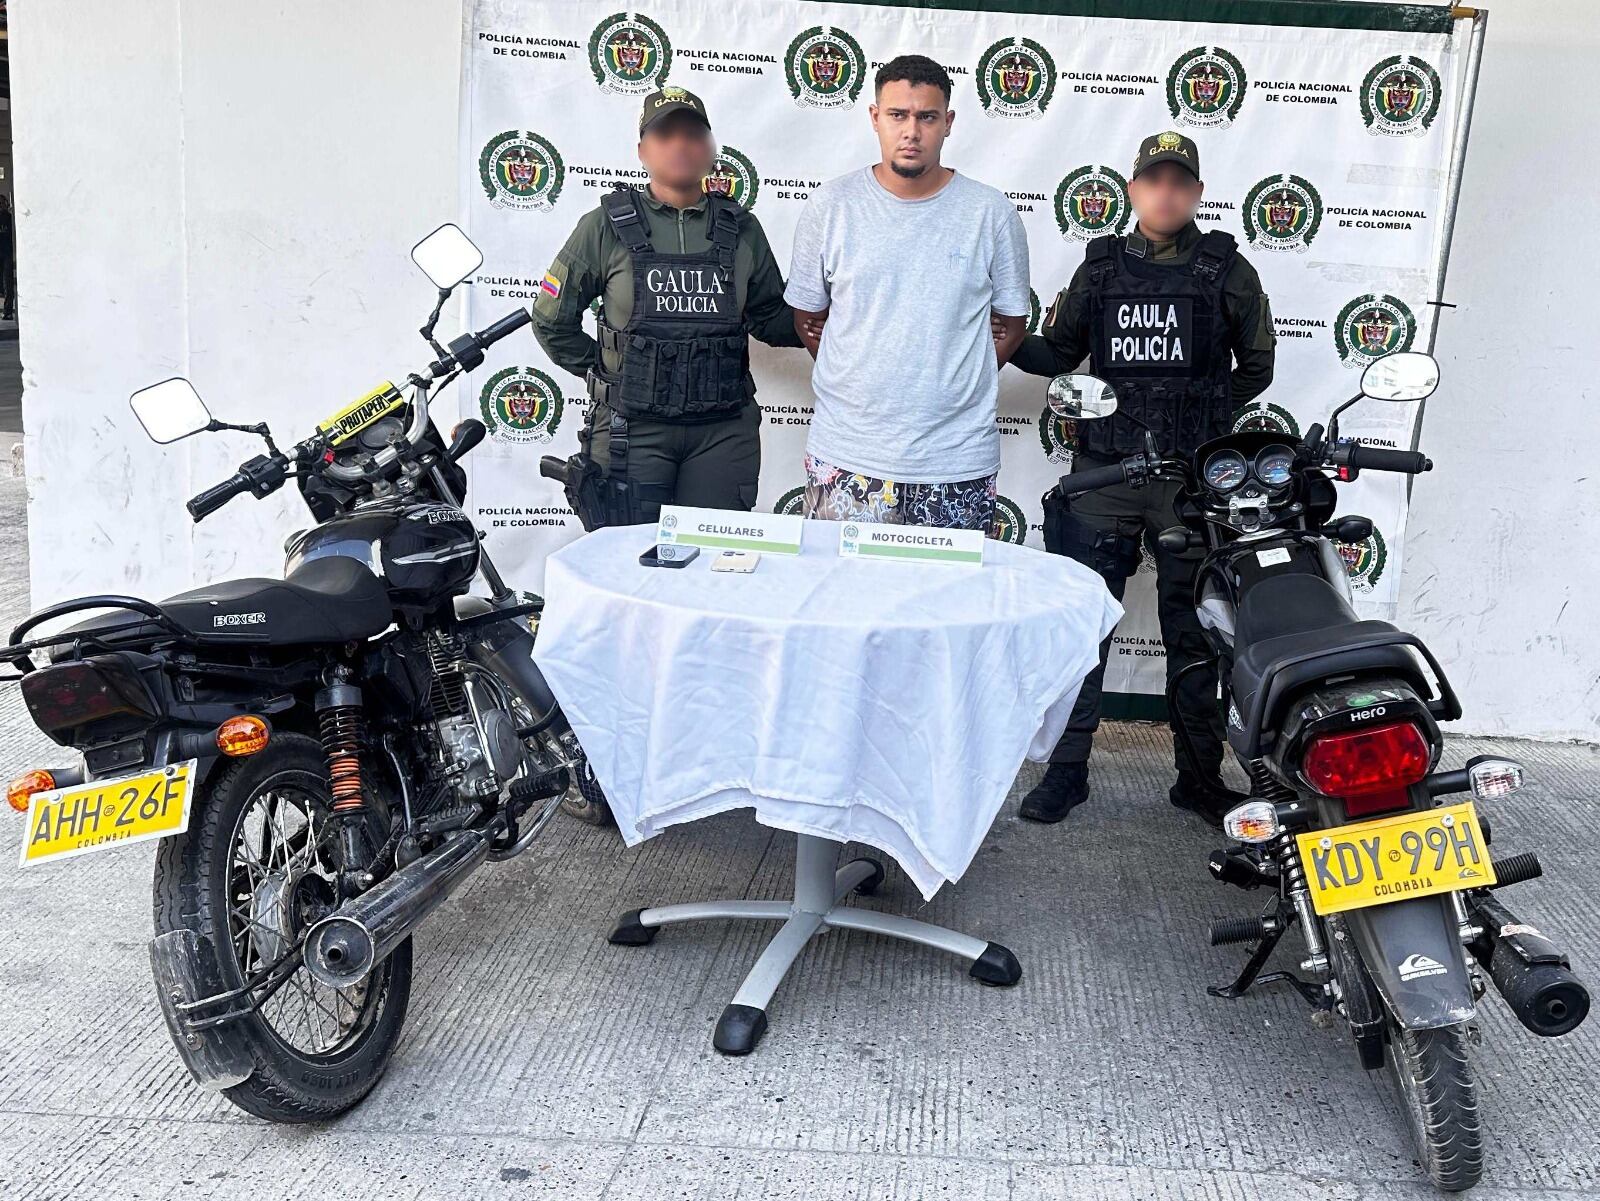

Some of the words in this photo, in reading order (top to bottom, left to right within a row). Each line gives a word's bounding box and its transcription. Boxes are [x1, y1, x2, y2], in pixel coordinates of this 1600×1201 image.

[479, 32, 522, 44] POLICÍA
[526, 38, 580, 48] NACIONAL
[493, 47, 507, 55] DE
[511, 49, 566, 60] COLOMBIA
[676, 49, 719, 60] POLICÍA
[723, 53, 777, 63] NACIONAL
[690, 63, 705, 71] DE
[707, 64, 763, 75] COLOMBIA
[1062, 72, 1102, 82] POLICÍA
[1106, 74, 1159, 84] NACIONAL
[1074, 85, 1087, 93] DE
[1090, 86, 1144, 96] COLOMBIA
[1254, 80, 1296, 91] POLICÍA
[1299, 83, 1352, 93] NACIONAL
[1266, 94, 1279, 102] DE
[1282, 95, 1338, 104] COLOMBIA
[570, 166, 612, 176] POLICÍA
[616, 170, 648, 178] NACIO
[764, 179, 805, 187] POLICÍA
[1004, 192, 1047, 200] ACIONAL
[1327, 206, 1368, 216] POLICÍA
[1372, 209, 1427, 218] NACIONAL
[1356, 221, 1412, 230] COLOMBIA
[477, 276, 520, 286] POLICÍA
[647, 269, 724, 294] GAULA
[509, 290, 538, 298] COLO
[656, 296, 718, 313] POLICIA
[1118, 304, 1178, 329] GAULA
[1274, 318, 1327, 327] NACIONAL
[1275, 330, 1312, 338] LOMBIA
[1111, 328, 1184, 362] POLICÍA
[340, 396, 385, 432] PROTAPER
[479, 507, 522, 515] POLICÍA
[698, 524, 764, 537] CELULARES
[872, 533, 953, 546] MOTOCICLETA
[1351, 567, 1372, 582] ACIONAL
[214, 612, 266, 627] BOXER
[1113, 637, 1145, 645] OLICÍA
[32, 794, 103, 845] AHH
[115, 776, 186, 827] 26F
[77, 830, 132, 849] COLOMBIA
[1311, 837, 1383, 890] KDY
[1400, 822, 1480, 875] 99H
[1374, 878, 1432, 896] COLOMBIA
